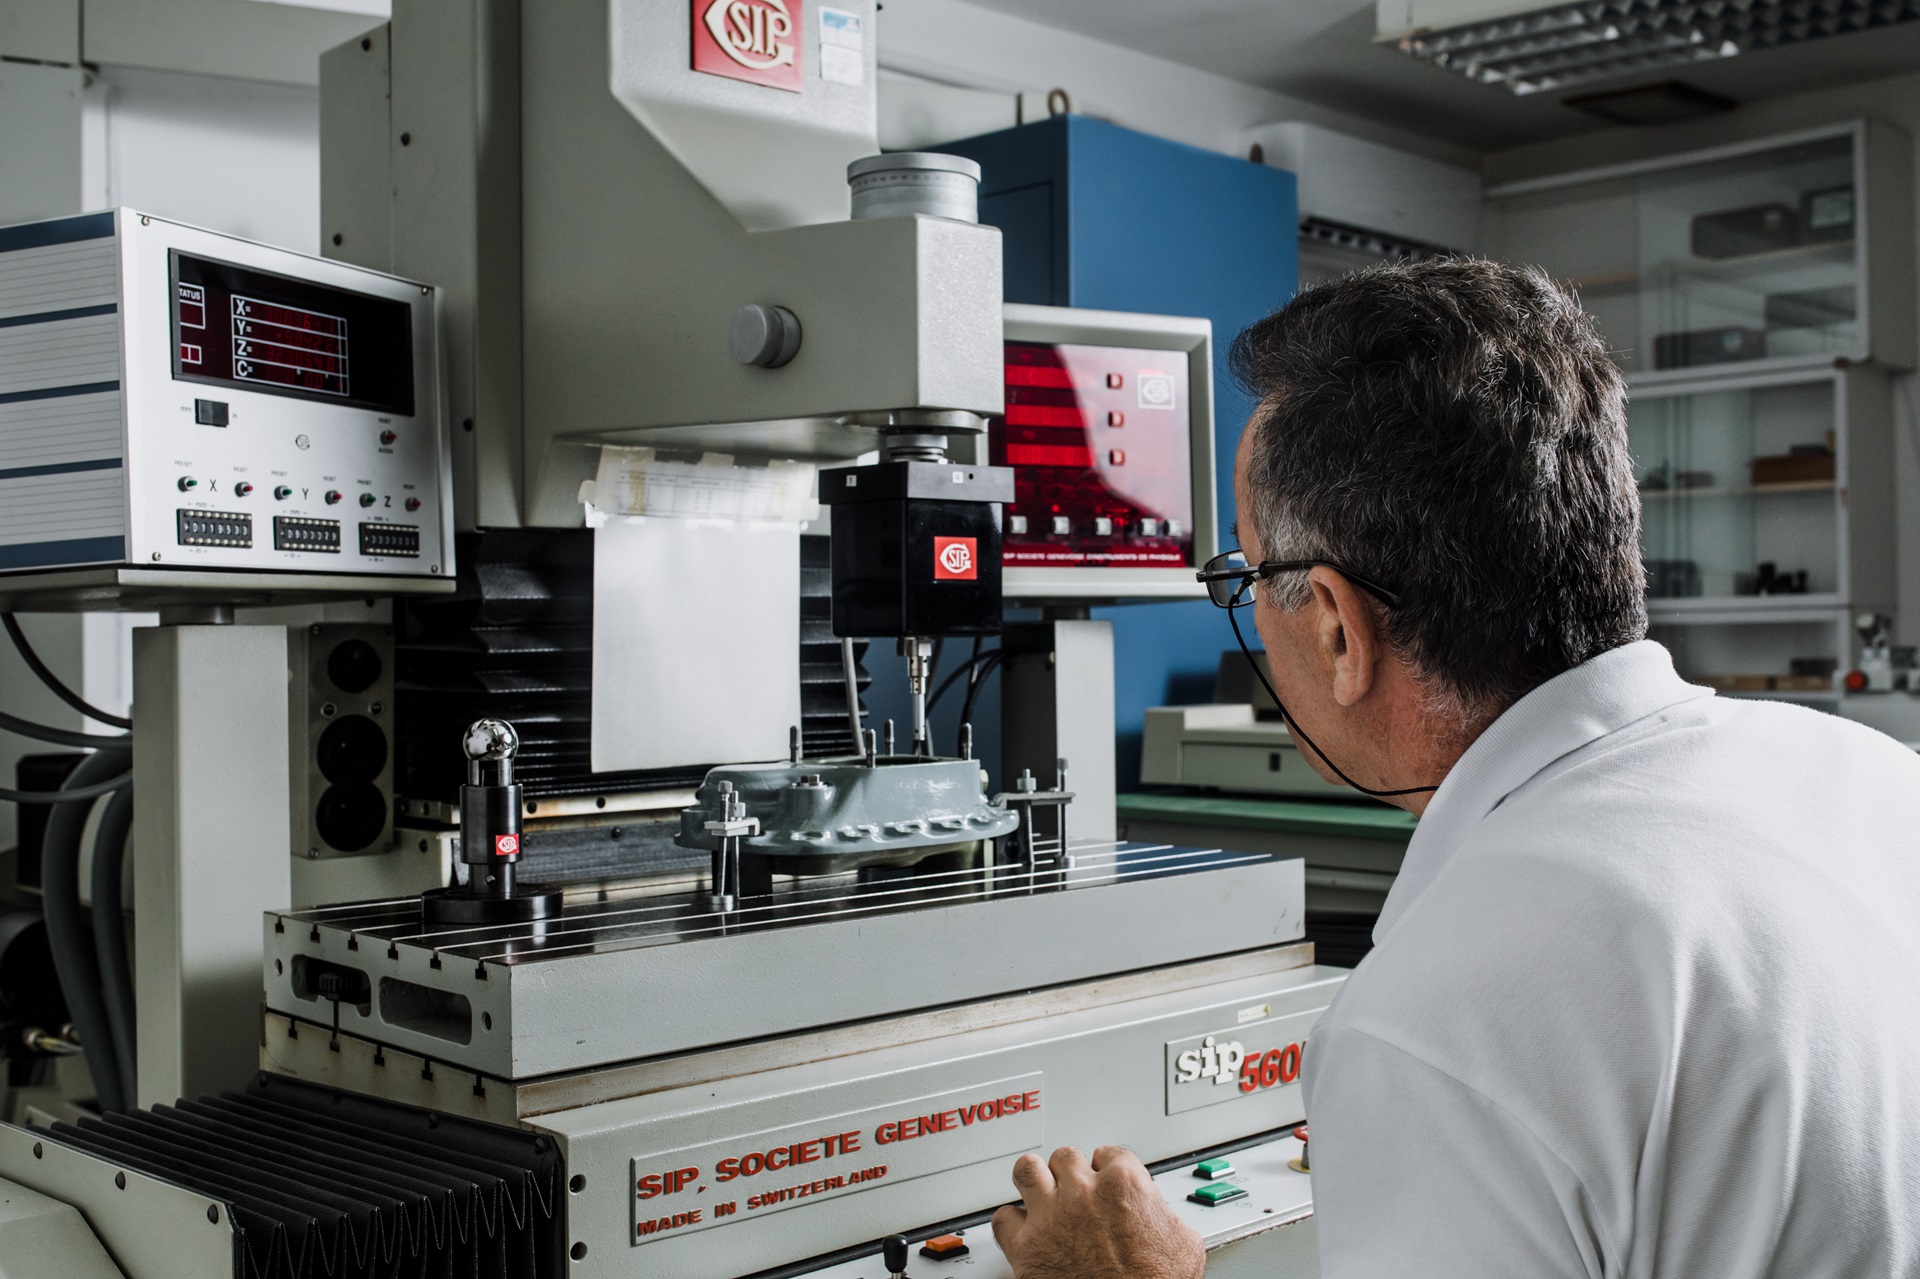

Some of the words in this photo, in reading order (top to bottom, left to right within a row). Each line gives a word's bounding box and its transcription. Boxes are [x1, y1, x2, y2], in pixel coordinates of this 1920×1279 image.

[179, 288, 201, 301] TATUS
[209, 479, 217, 492] X
[302, 488, 309, 500] Y
[384, 495, 391, 508] Z
[945, 546, 971, 569] SIP
[1175, 1036, 1245, 1085] sip
[715, 1130, 862, 1183] SOCIETE
[875, 1089, 1040, 1147] GENEVOISE
[637, 1208, 704, 1238] MADE
[715, 1201, 737, 1219] IN
[747, 1165, 888, 1211] SWITZERLAND
